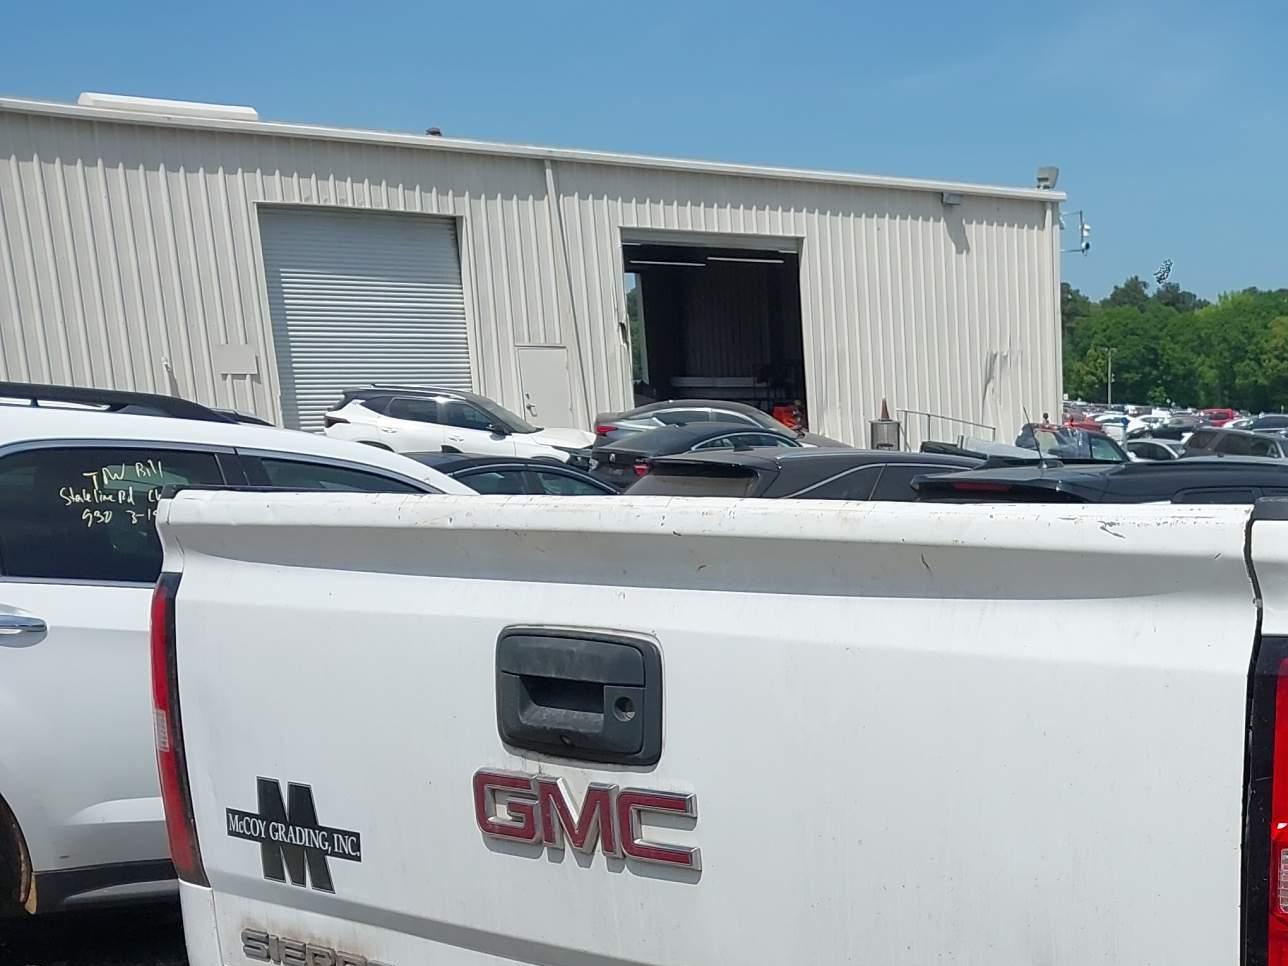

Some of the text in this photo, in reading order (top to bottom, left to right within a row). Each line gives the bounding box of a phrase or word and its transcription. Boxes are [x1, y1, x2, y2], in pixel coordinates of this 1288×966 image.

[228, 813, 360, 857] McCOY GRADING, INC.
[473, 767, 702, 872] GMC
